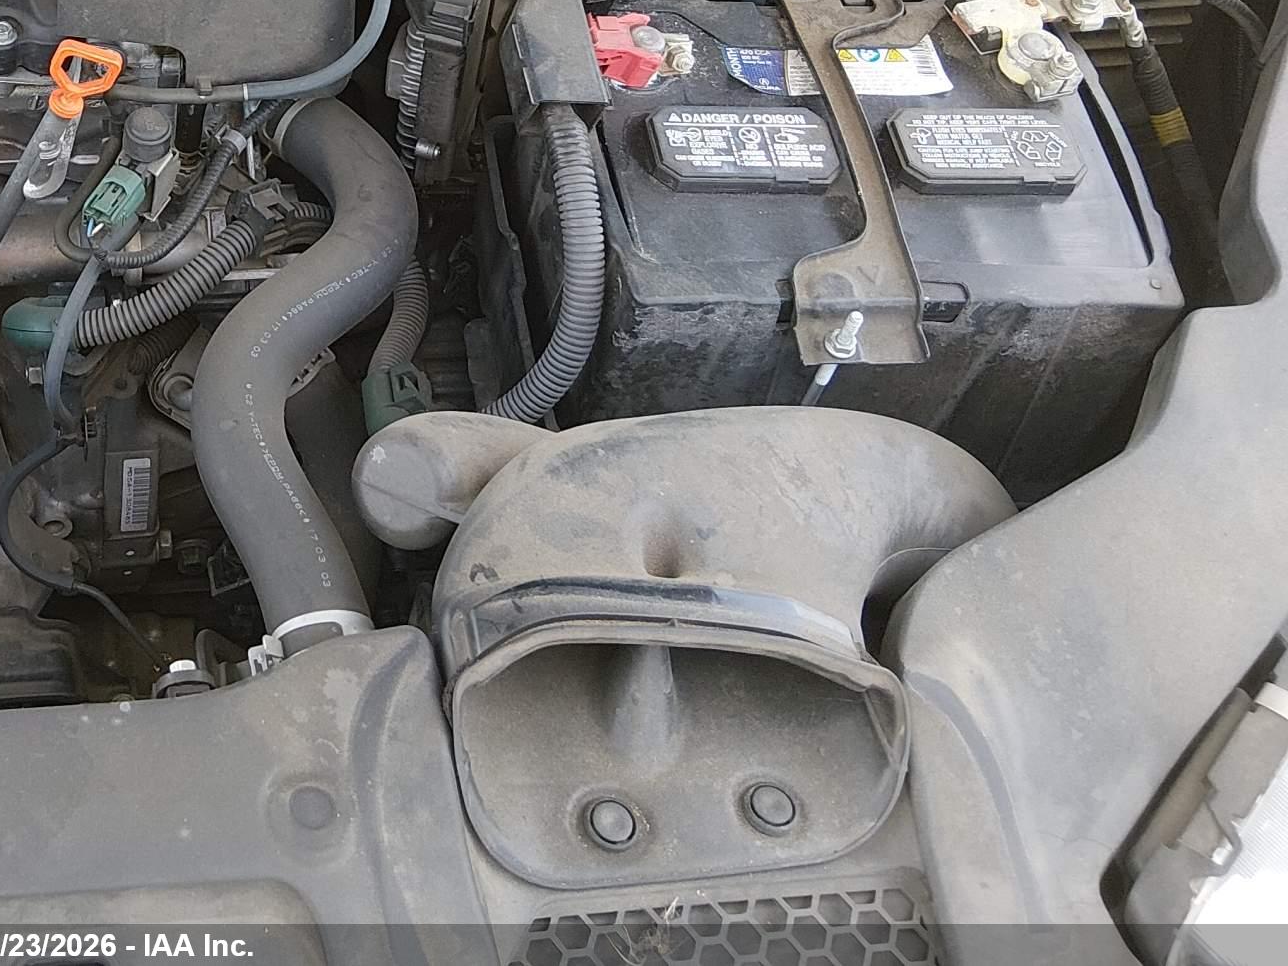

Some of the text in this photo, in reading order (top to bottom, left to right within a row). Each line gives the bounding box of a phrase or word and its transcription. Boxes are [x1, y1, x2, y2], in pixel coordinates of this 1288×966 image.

[681, 113, 740, 124] DANGER
[753, 114, 807, 125] POISON
[250, 345, 261, 358] 03
[315, 546, 326, 563] 03
[320, 571, 331, 588] 03
